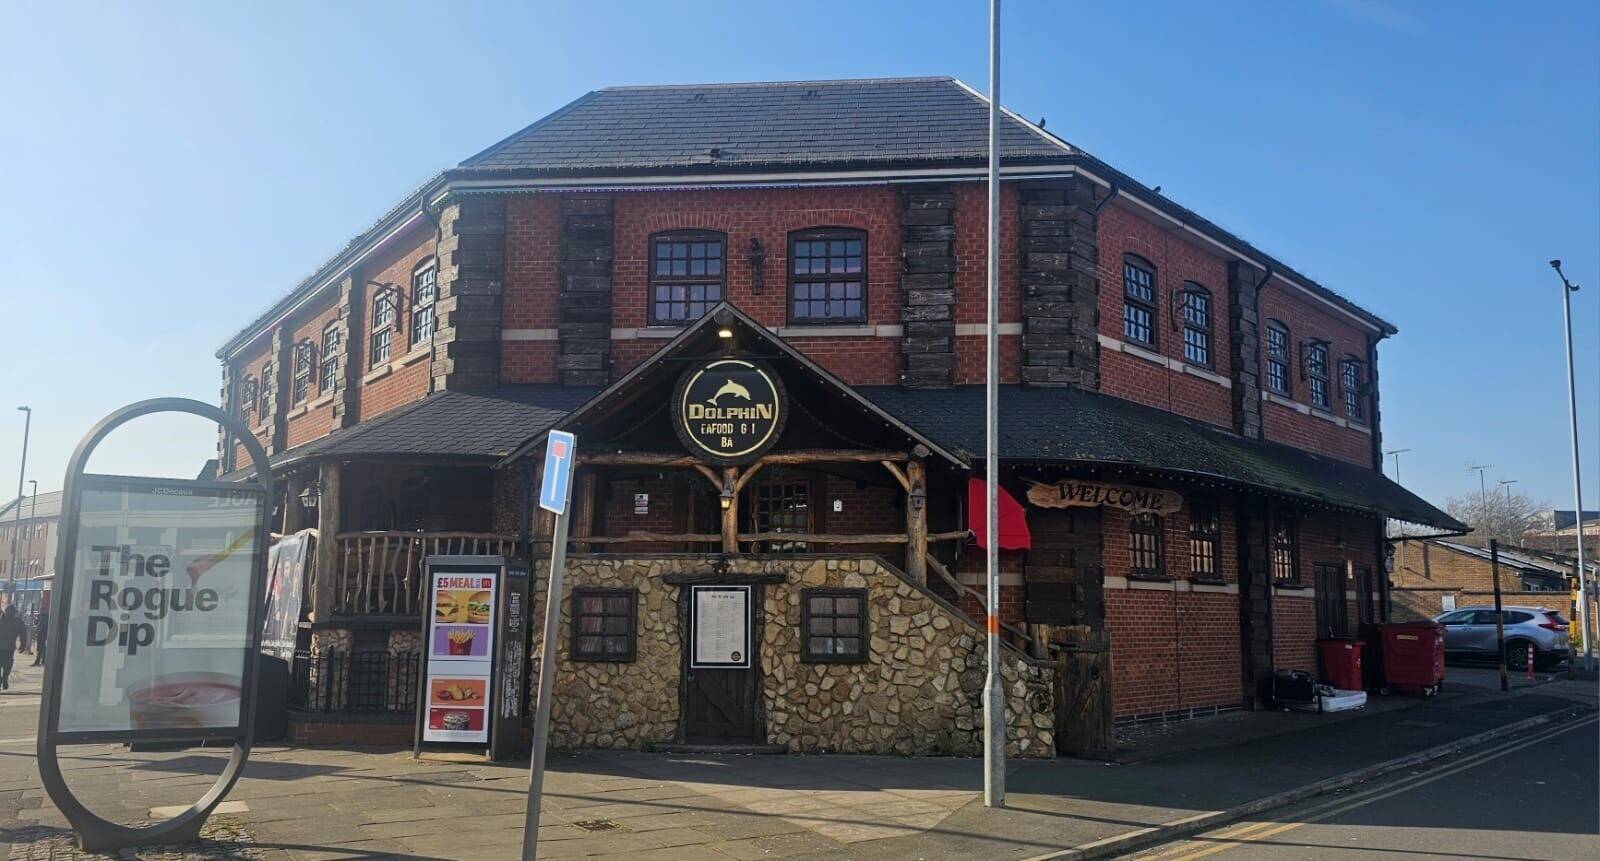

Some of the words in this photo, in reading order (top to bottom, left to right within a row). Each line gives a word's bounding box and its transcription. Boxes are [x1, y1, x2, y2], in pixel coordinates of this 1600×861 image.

[688, 404, 772, 419] DOLPHIN
[1059, 484, 1164, 509] WELCOME
[92, 545, 170, 577] The
[89, 580, 218, 620] Rogue
[86, 614, 155, 656] Dip
